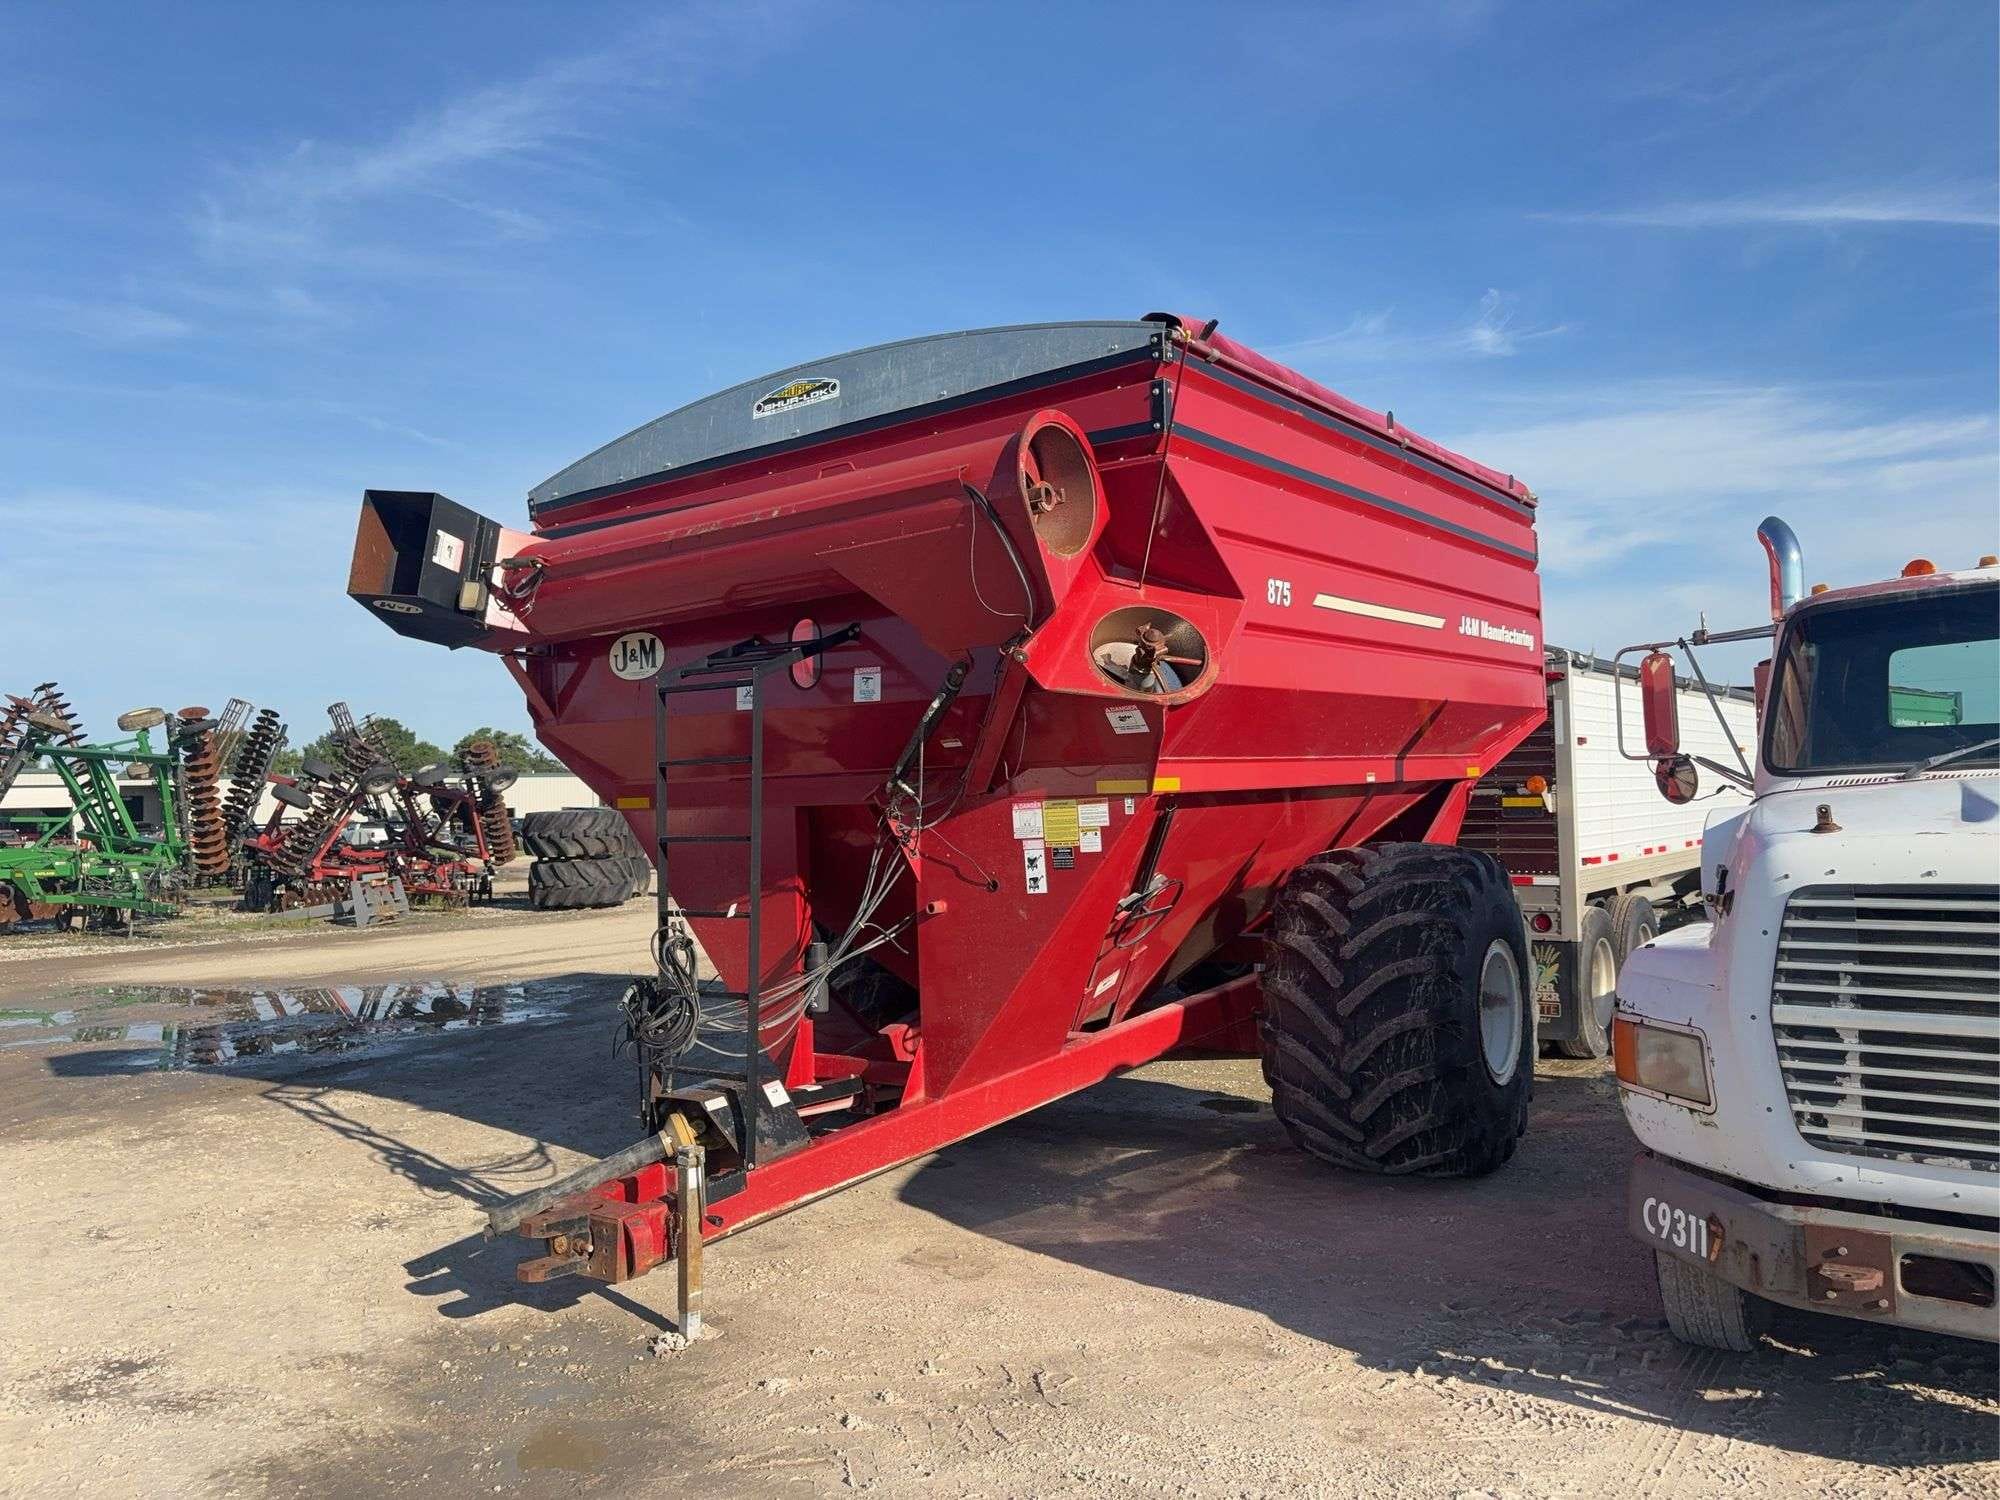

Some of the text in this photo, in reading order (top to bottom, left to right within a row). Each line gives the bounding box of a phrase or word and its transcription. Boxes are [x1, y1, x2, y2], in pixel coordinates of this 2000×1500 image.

[1267, 577, 1291, 608] 875
[1459, 615, 1535, 652] J&M Manufacturing
[613, 637, 657, 672] J&M
[1643, 1197, 1707, 1259] C9311
